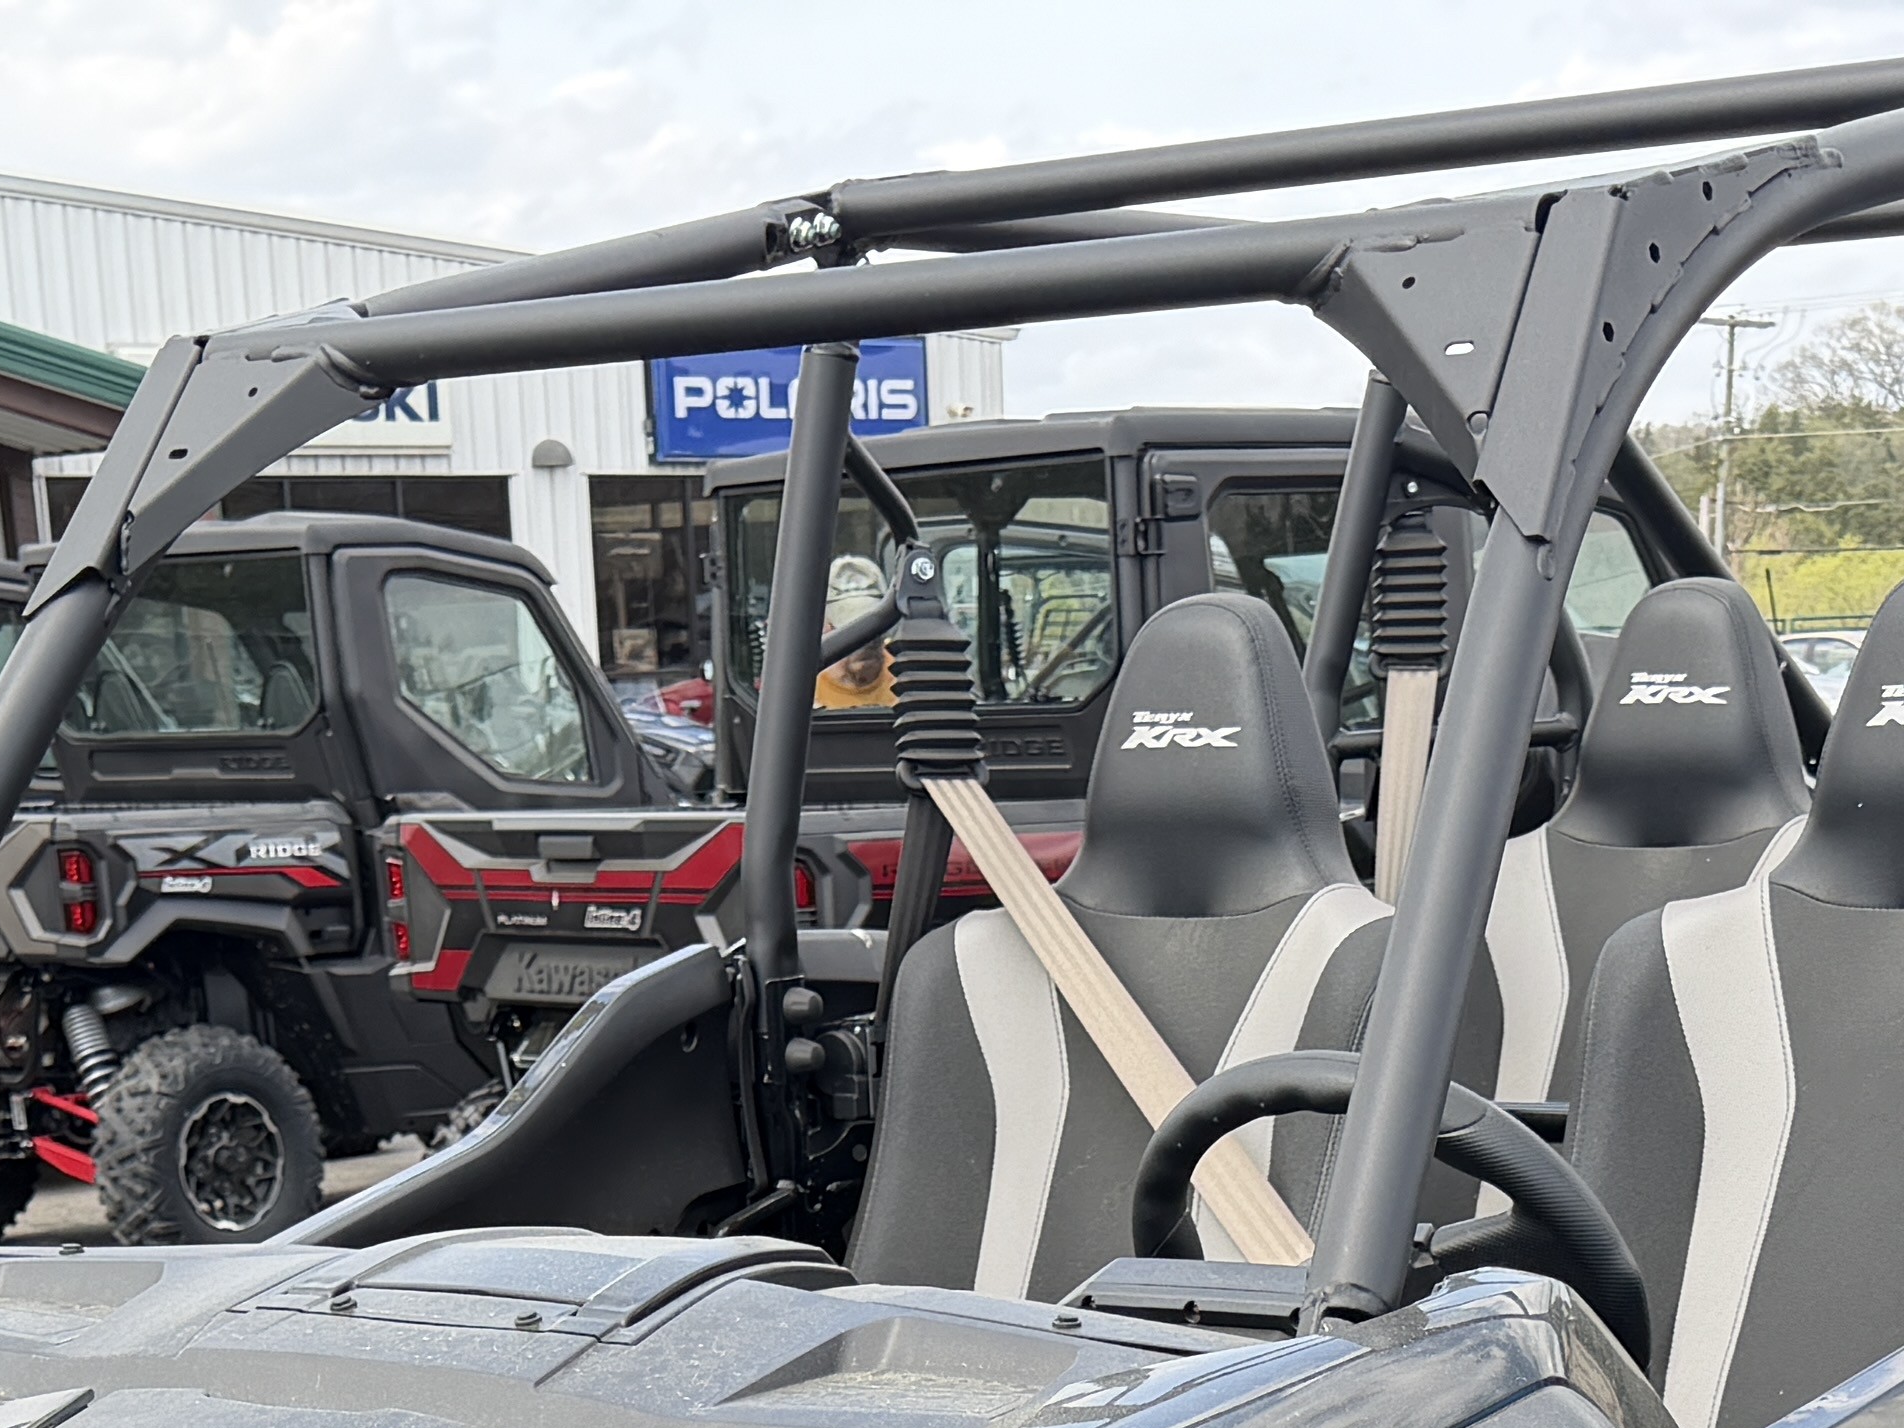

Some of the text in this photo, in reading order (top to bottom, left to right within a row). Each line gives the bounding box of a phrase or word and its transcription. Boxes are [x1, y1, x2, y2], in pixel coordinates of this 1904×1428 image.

[1619, 685, 1731, 704] KRX
[1120, 725, 1242, 750] KRX
[250, 842, 323, 859] RIDGE
